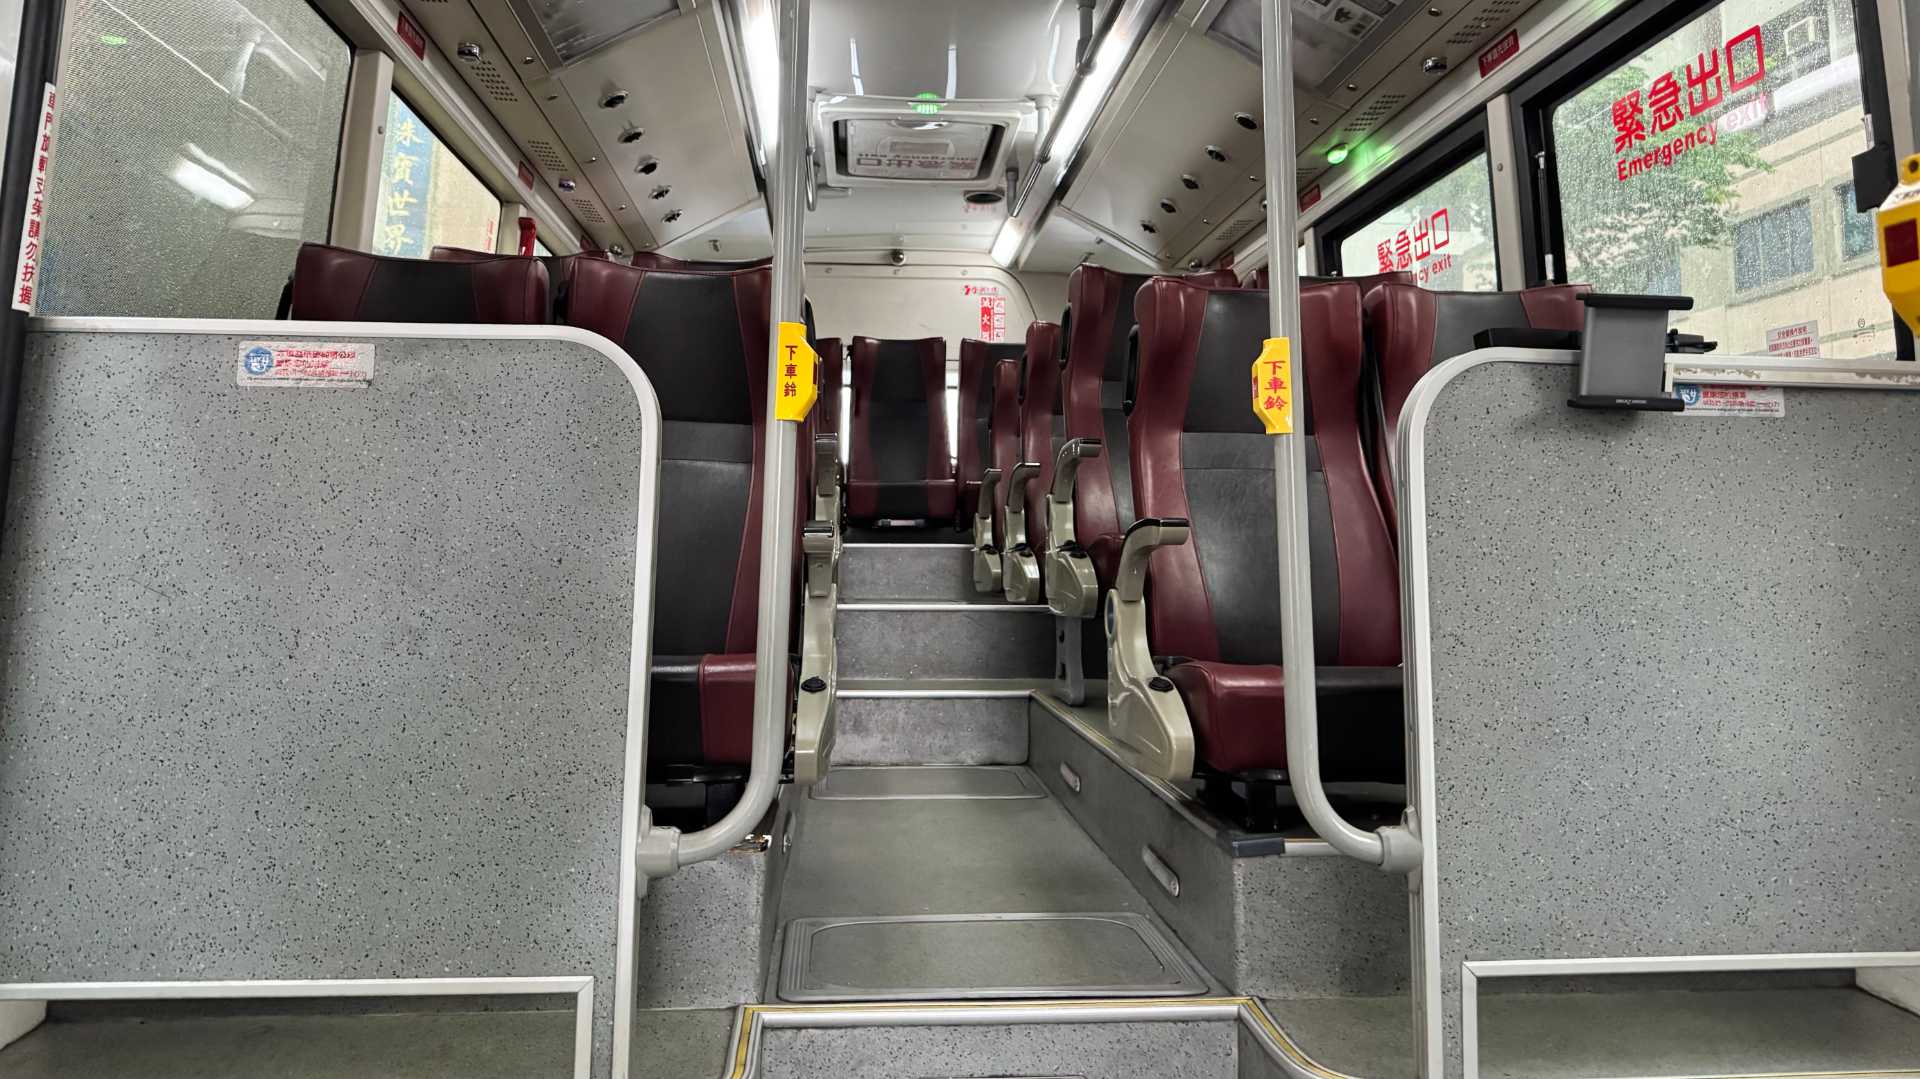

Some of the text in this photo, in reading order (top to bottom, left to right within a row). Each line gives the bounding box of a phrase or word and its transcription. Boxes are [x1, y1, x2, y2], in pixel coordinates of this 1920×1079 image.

[1612, 25, 1765, 155] 緊急出口
[856, 157, 977, 170] 緊急出口
[1616, 93, 1769, 182] Emergency exit
[1377, 208, 1450, 273] 緊急出口
[1432, 253, 1452, 274] exit
[784, 345, 798, 397] 下車鈴
[1263, 360, 1287, 410] 下車鈴
